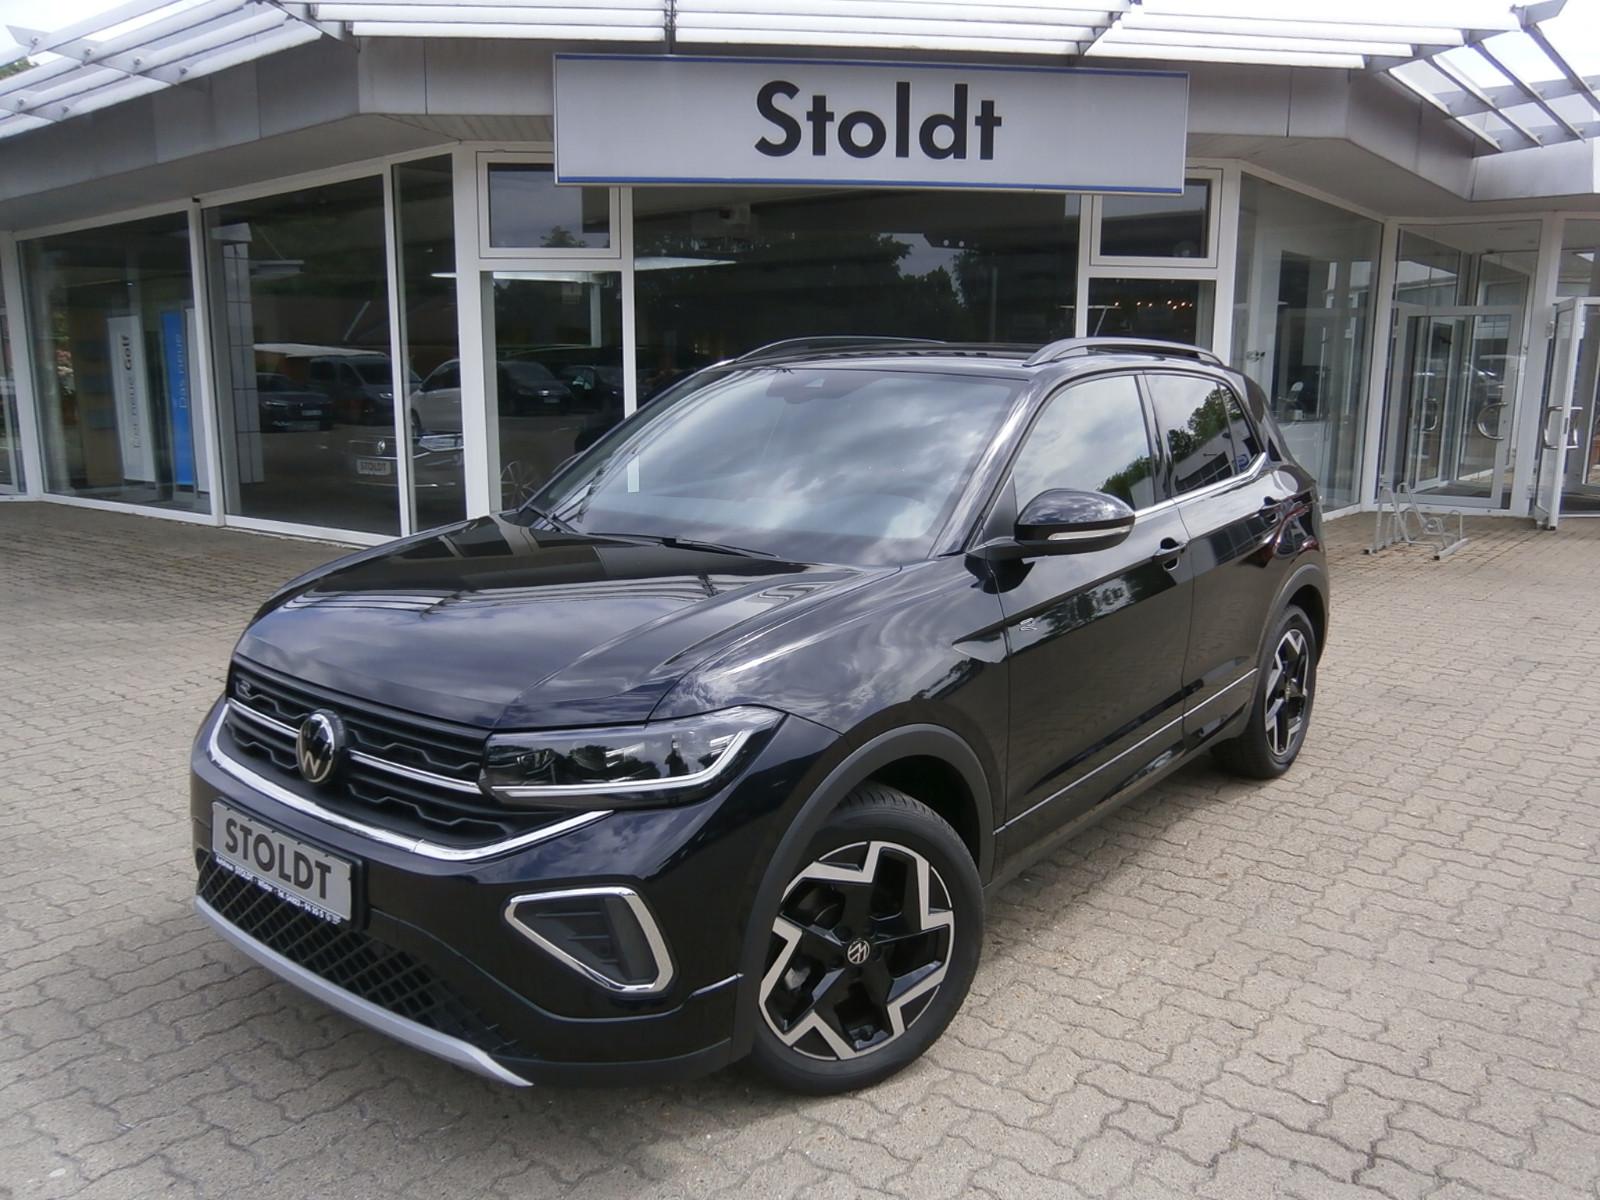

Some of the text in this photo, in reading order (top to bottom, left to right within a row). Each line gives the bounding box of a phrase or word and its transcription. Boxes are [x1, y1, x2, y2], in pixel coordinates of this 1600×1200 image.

[754, 80, 1002, 160] Stoldt
[121, 335, 133, 370] Golf
[224, 817, 332, 901] STOLDT
